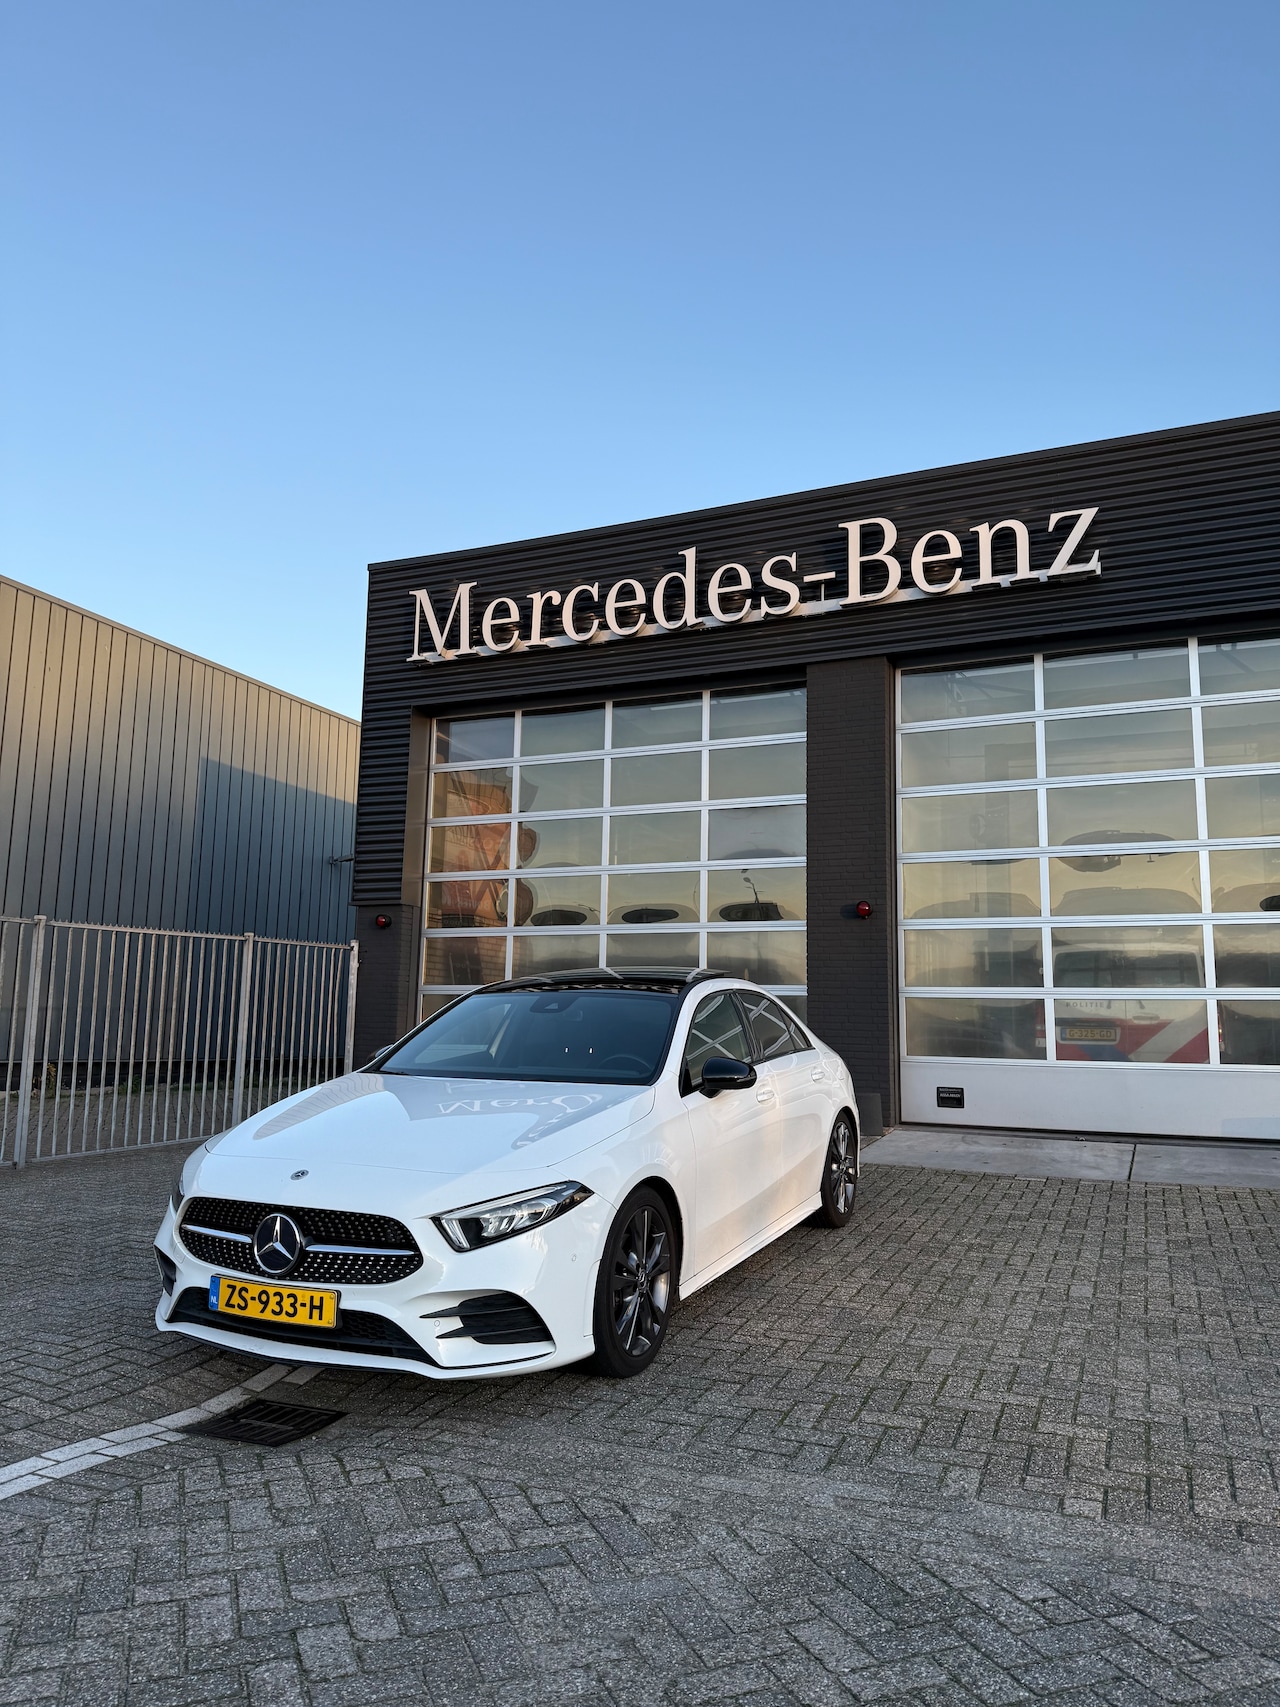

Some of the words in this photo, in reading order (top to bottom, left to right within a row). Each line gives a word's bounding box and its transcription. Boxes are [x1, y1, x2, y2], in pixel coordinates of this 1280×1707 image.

[406, 507, 1101, 662] Mercedes-Benz
[1065, 1001, 1105, 1009] POLITIE
[1068, 1028, 1112, 1038] G-325-GD
[210, 1295, 218, 1304] NL
[224, 1284, 324, 1320] ZS-933-H
